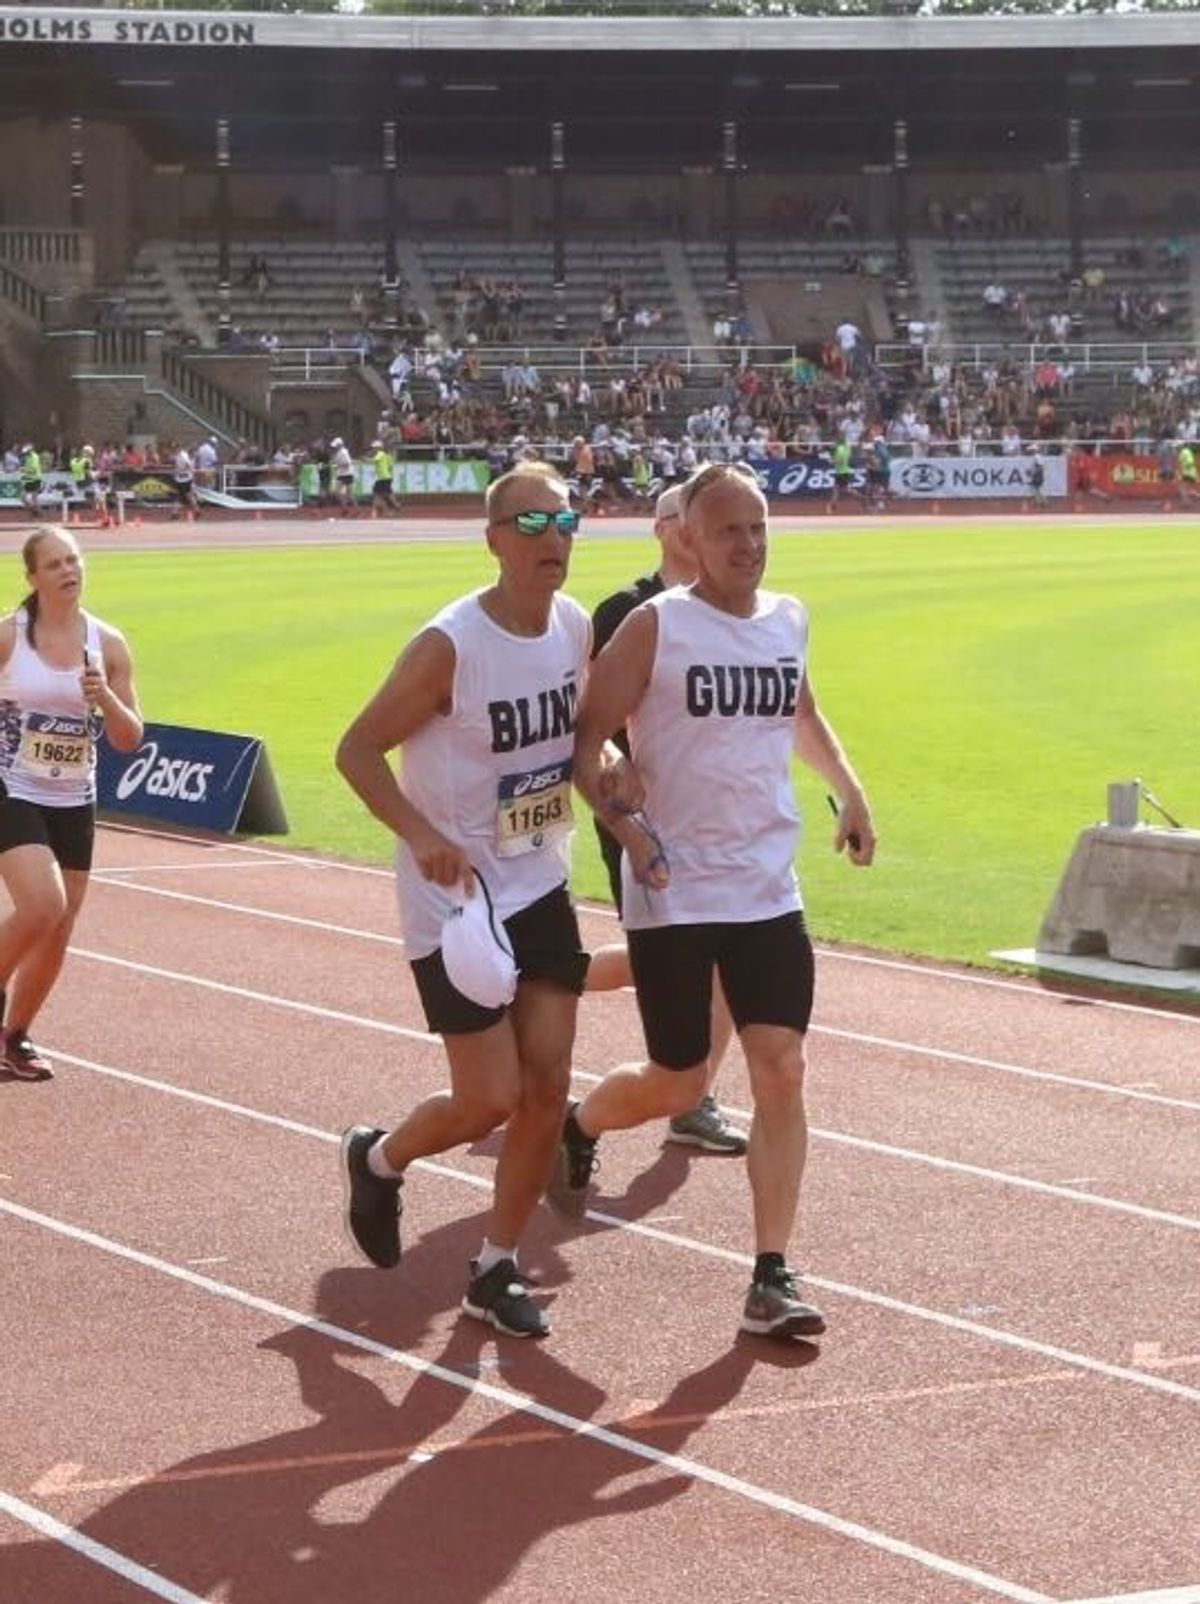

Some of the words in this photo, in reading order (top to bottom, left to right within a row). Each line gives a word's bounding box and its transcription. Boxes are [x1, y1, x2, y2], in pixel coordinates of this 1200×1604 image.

[115, 21, 254, 43] STADION
[686, 664, 798, 717] GUIDE
[33, 742, 83, 763] 19622
[146, 757, 215, 802] asics
